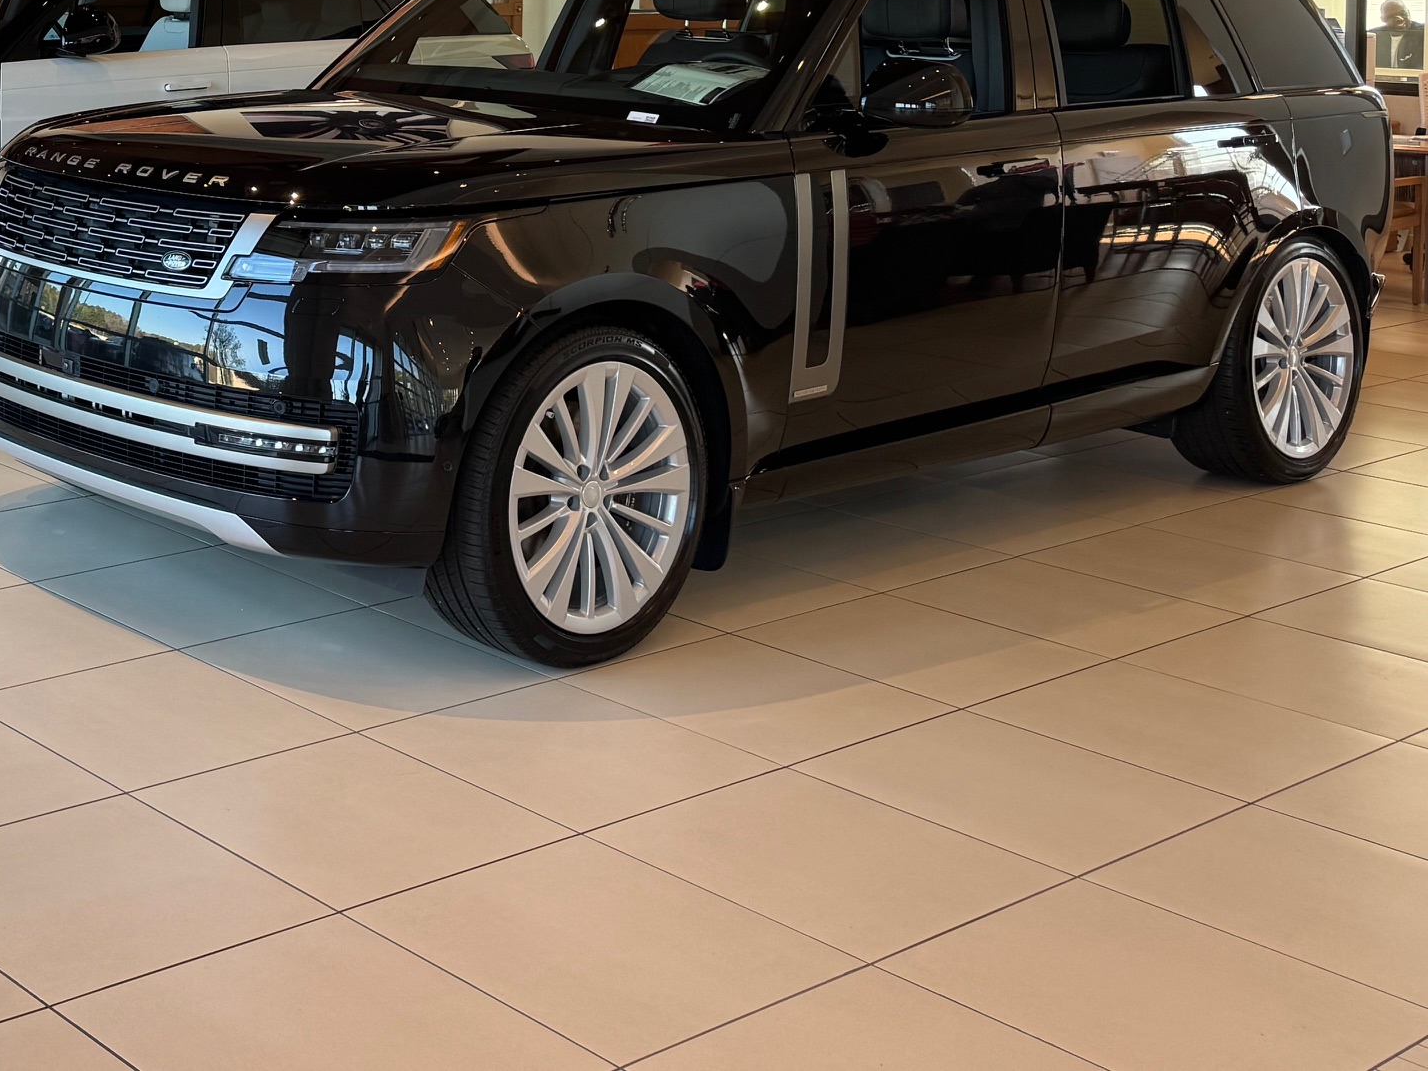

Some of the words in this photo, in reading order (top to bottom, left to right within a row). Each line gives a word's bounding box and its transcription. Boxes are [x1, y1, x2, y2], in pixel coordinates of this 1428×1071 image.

[25, 146, 100, 169] RANGE
[115, 163, 230, 187] ROVER
[562, 336, 622, 360] SCORPION
[626, 337, 643, 348] MS
